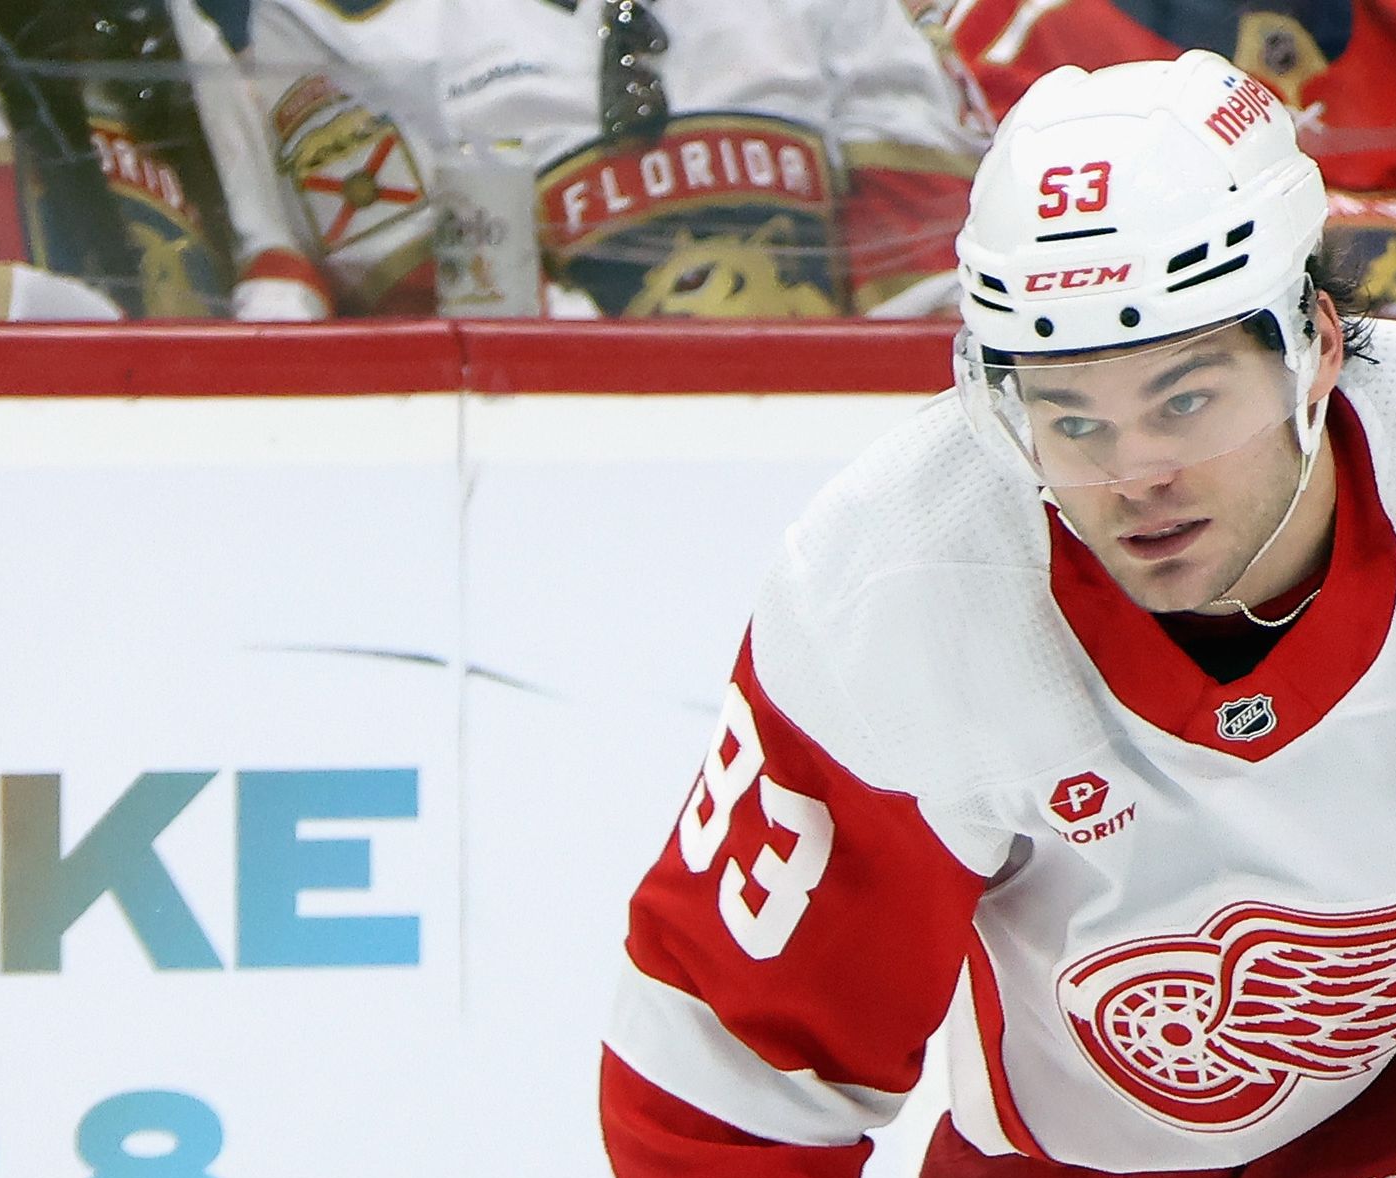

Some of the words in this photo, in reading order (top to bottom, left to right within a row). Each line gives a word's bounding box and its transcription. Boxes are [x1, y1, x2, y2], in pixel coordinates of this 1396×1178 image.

[560, 138, 810, 233] FLORIDA
[1024, 263, 1132, 293] CCM
[1230, 705, 1264, 734] NHL
